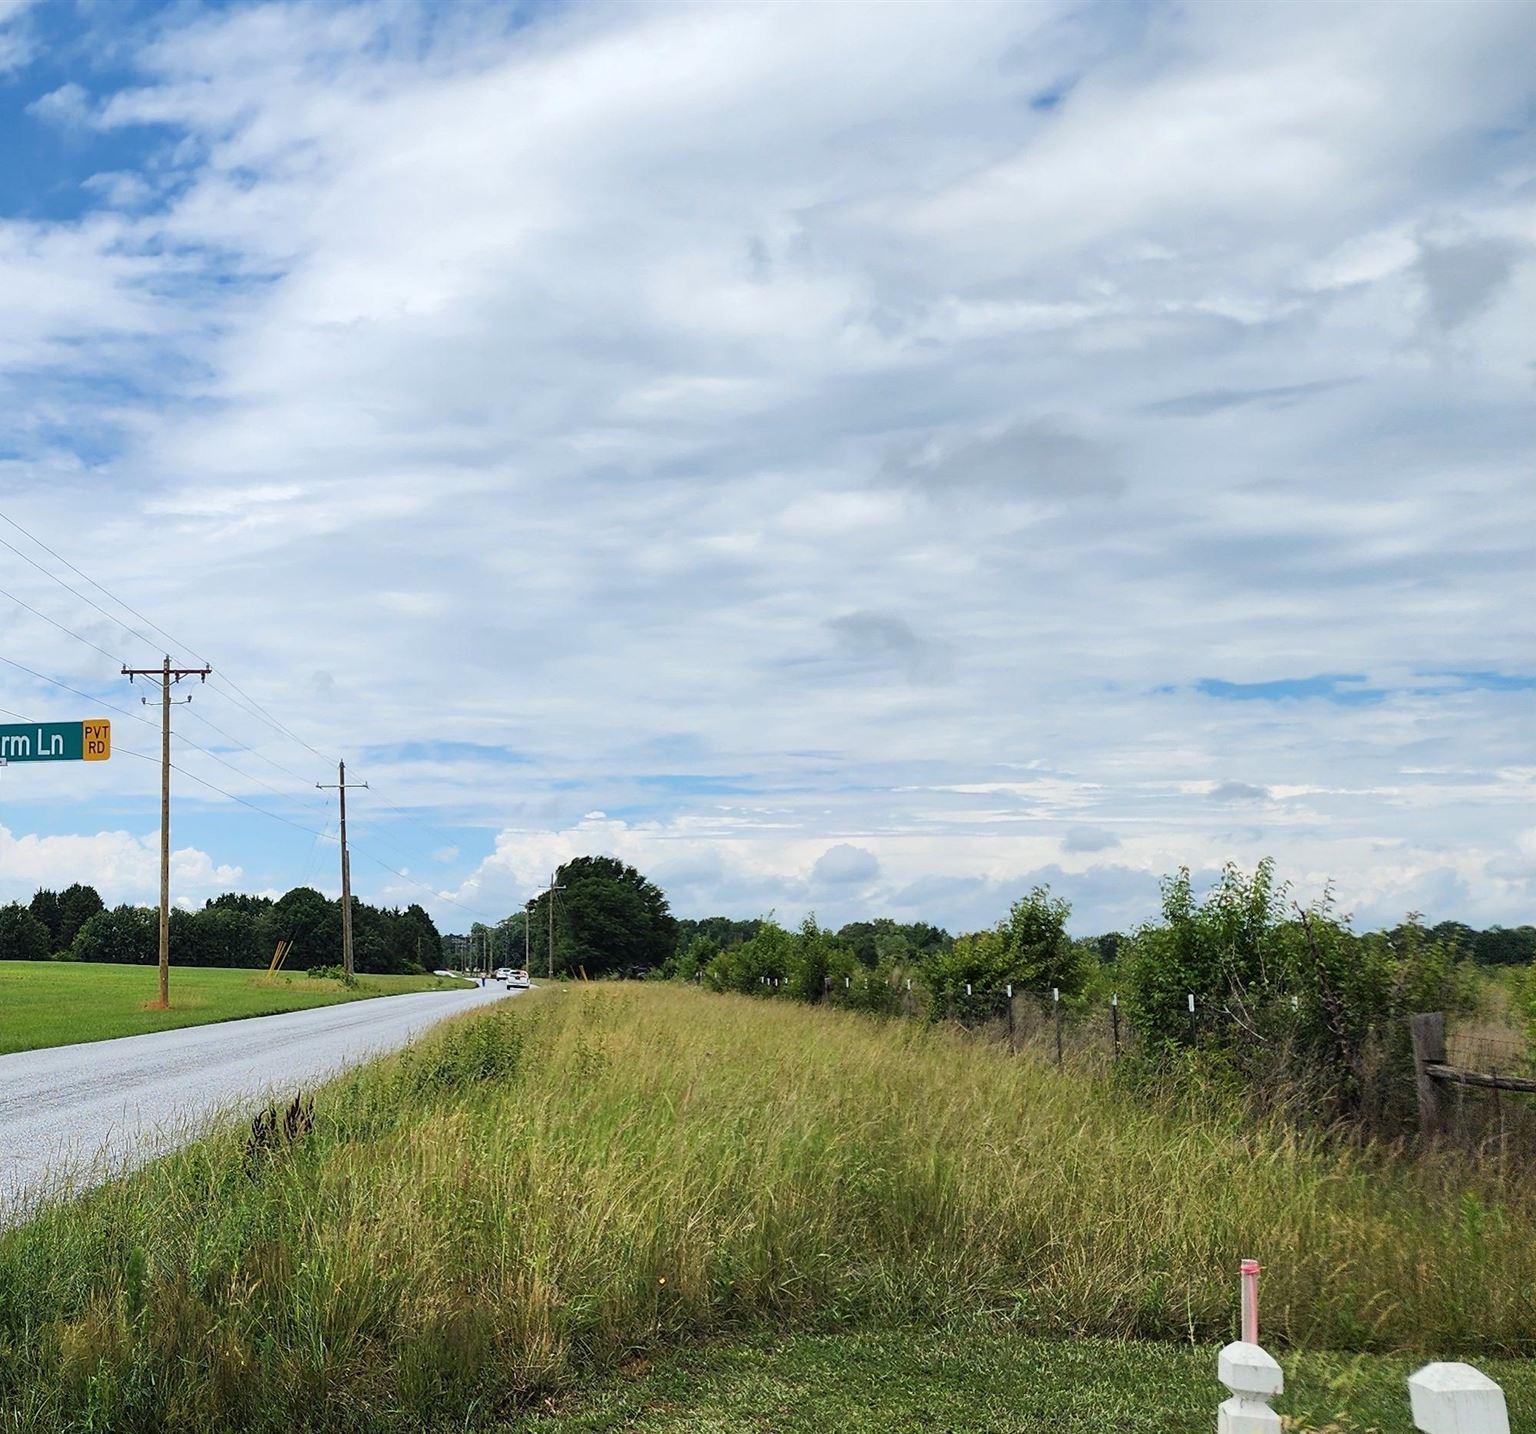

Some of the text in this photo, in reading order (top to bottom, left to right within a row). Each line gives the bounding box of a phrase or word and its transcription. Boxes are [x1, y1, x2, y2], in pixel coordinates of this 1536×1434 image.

[84, 725, 109, 740] PVT
[37, 728, 64, 756] Ln
[88, 740, 106, 755] RD
